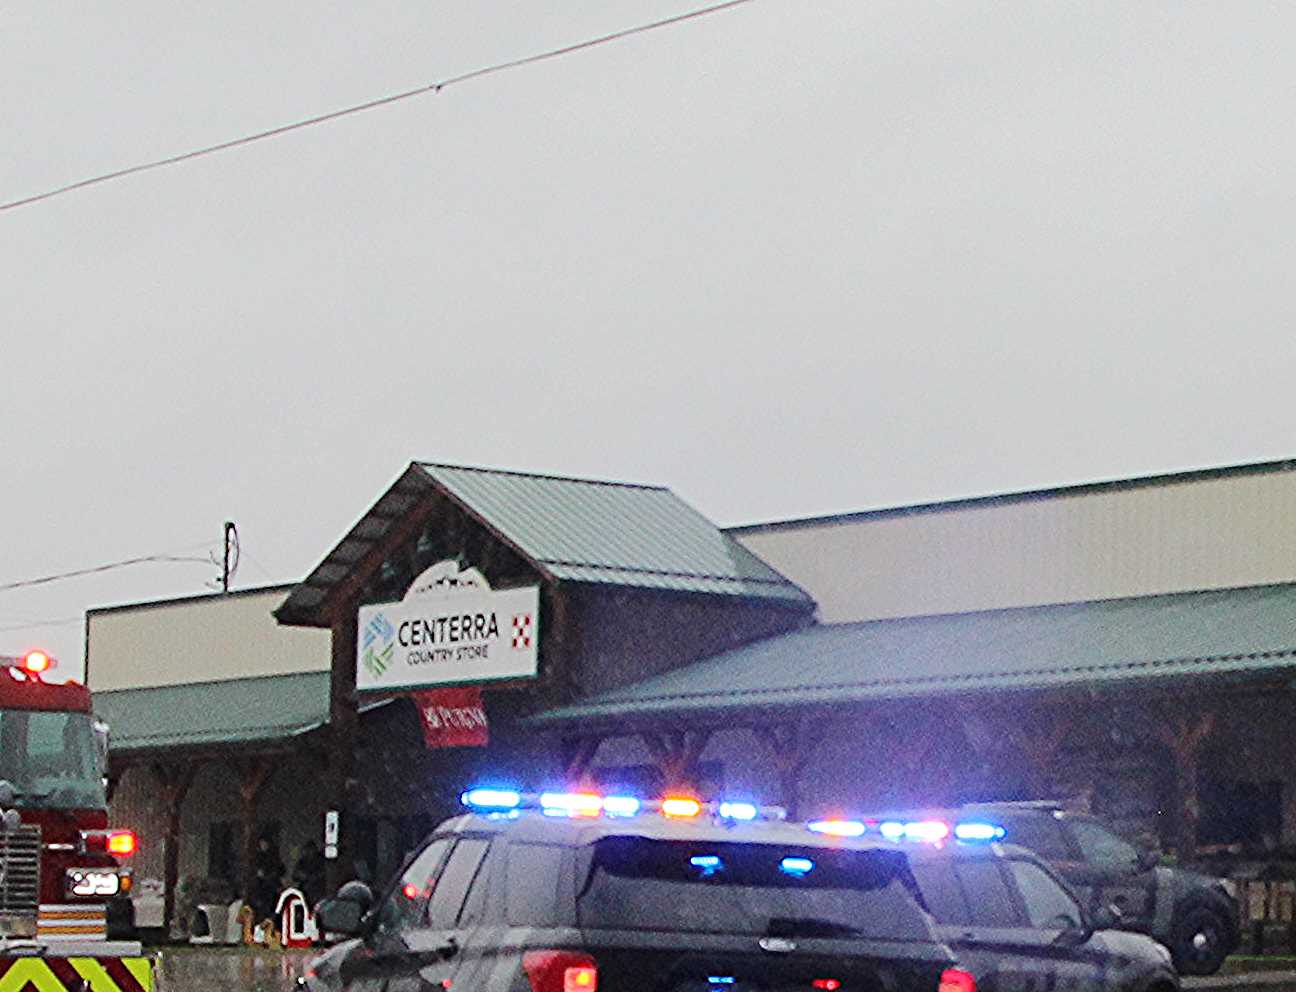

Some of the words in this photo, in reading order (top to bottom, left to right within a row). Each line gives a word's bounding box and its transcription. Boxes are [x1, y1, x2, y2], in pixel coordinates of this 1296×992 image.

[398, 612, 499, 647] CENTERRA
[407, 648, 453, 666] COUNTRY
[456, 644, 489, 661] STORE
